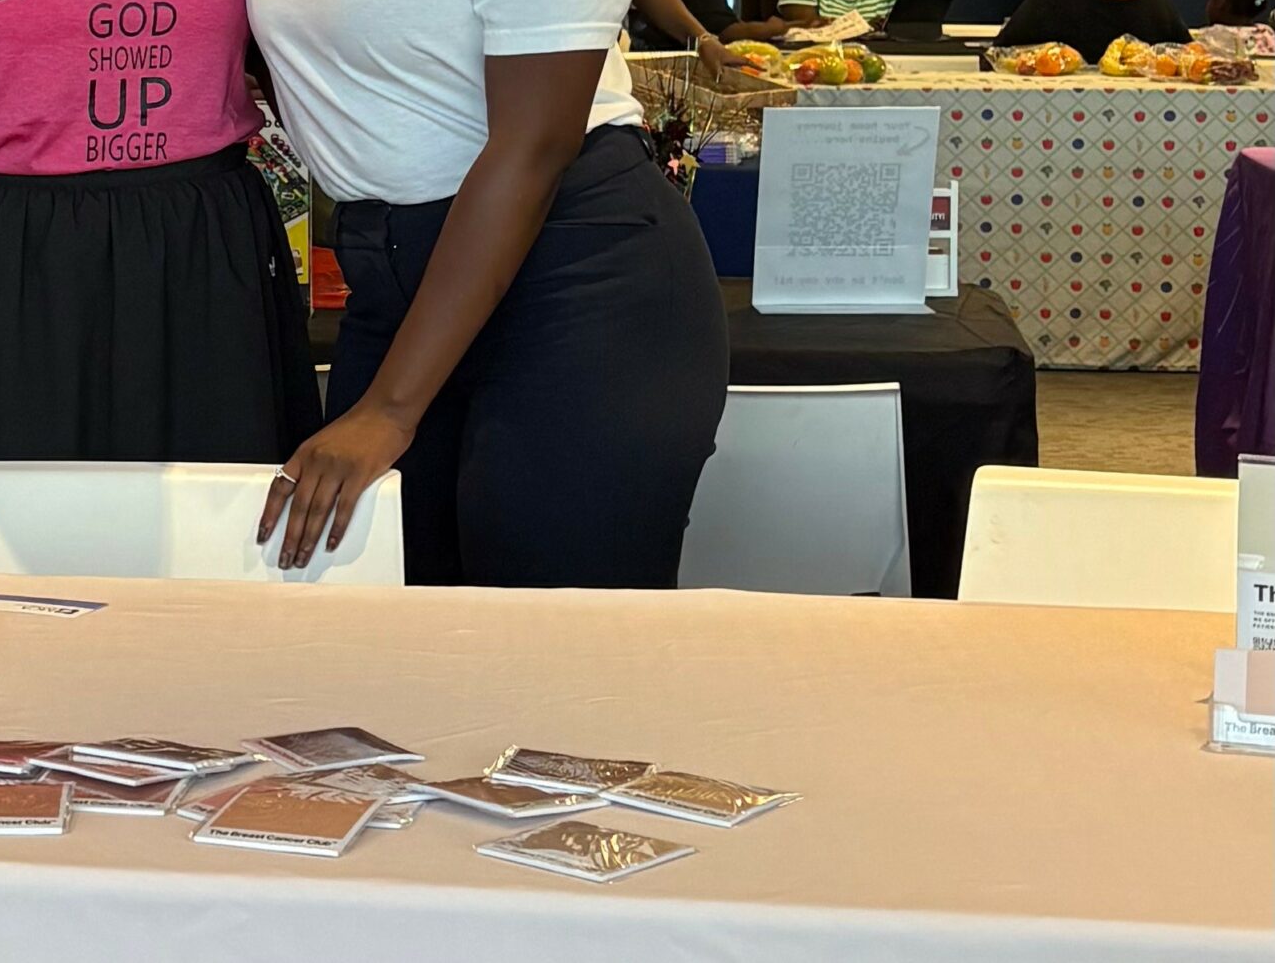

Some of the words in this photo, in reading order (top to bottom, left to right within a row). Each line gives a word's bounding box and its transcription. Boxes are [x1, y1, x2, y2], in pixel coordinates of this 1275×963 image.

[88, 1, 178, 38] GOD
[89, 44, 173, 72] SHOWED
[88, 76, 172, 130] UP
[86, 132, 168, 162] BIGGER
[210, 828, 226, 836] The
[229, 830, 266, 840] Breast
[265, 833, 305, 845] Cancer
